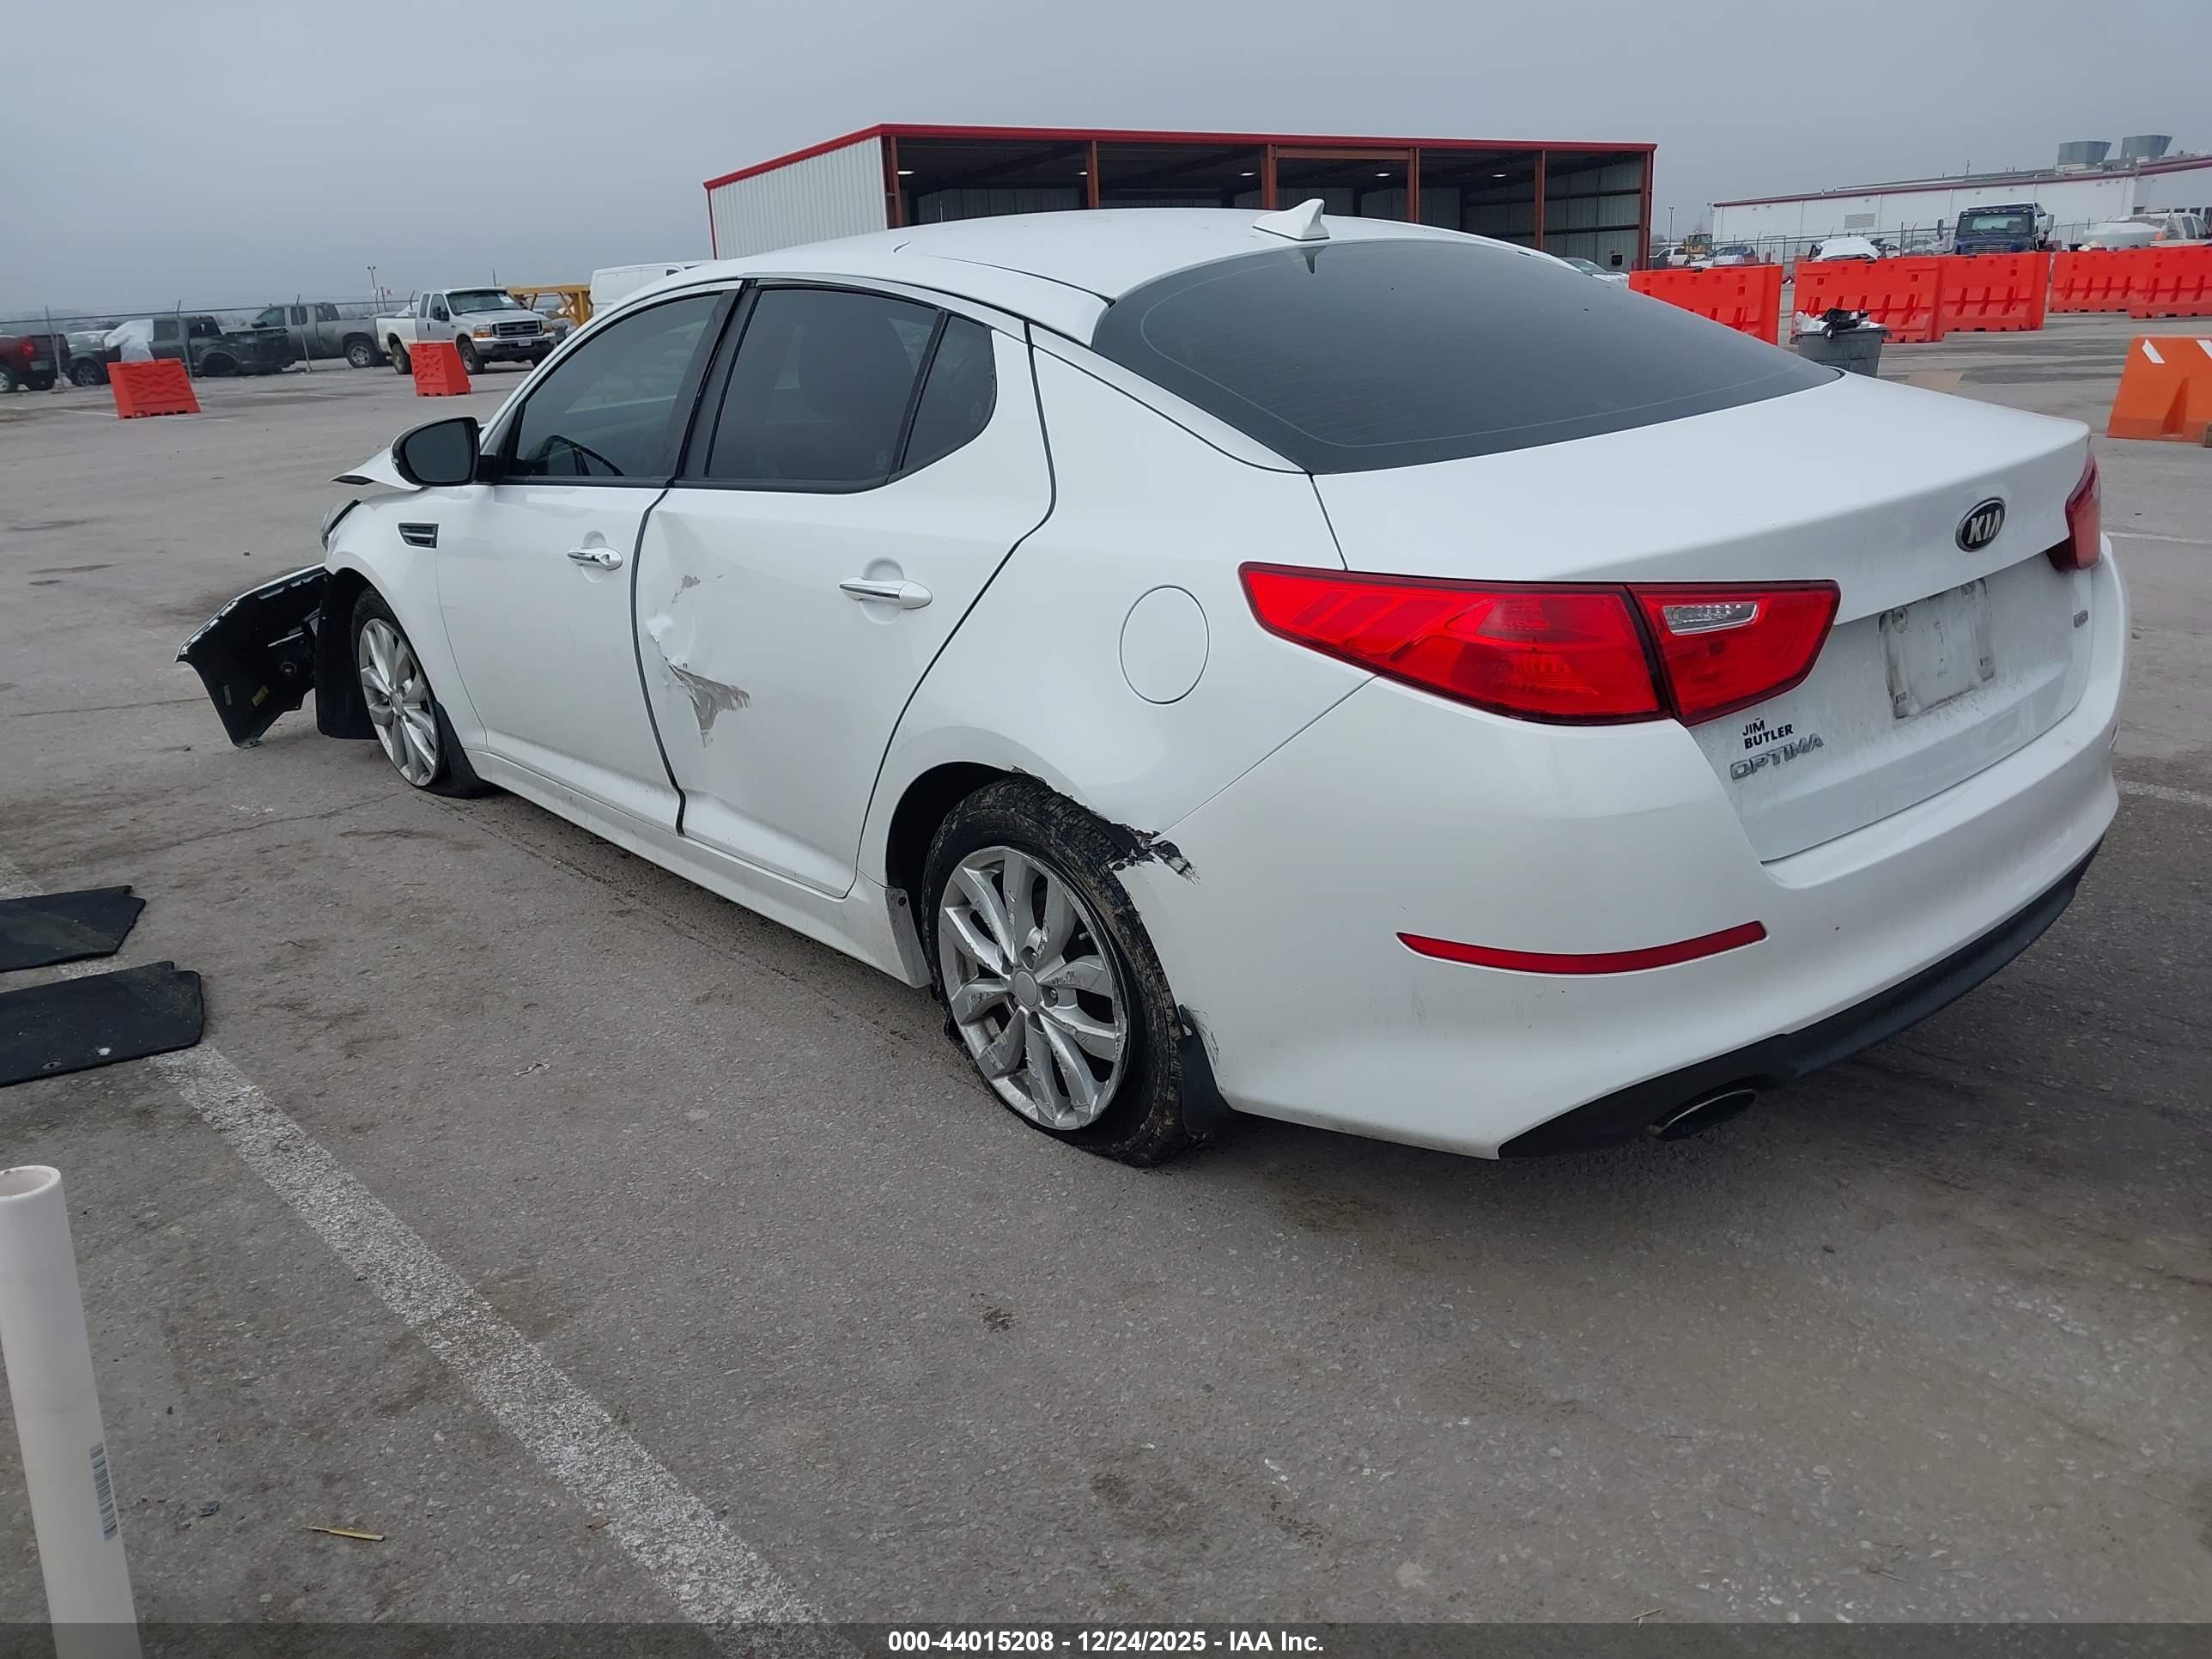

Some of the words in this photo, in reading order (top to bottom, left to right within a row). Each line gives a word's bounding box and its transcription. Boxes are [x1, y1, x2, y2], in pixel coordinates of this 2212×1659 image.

[1966, 509, 2001, 544] KIA
[1742, 720, 1765, 736] JIM
[1744, 724, 1793, 750] BUTLER
[1730, 733, 1825, 780] OPTIMA
